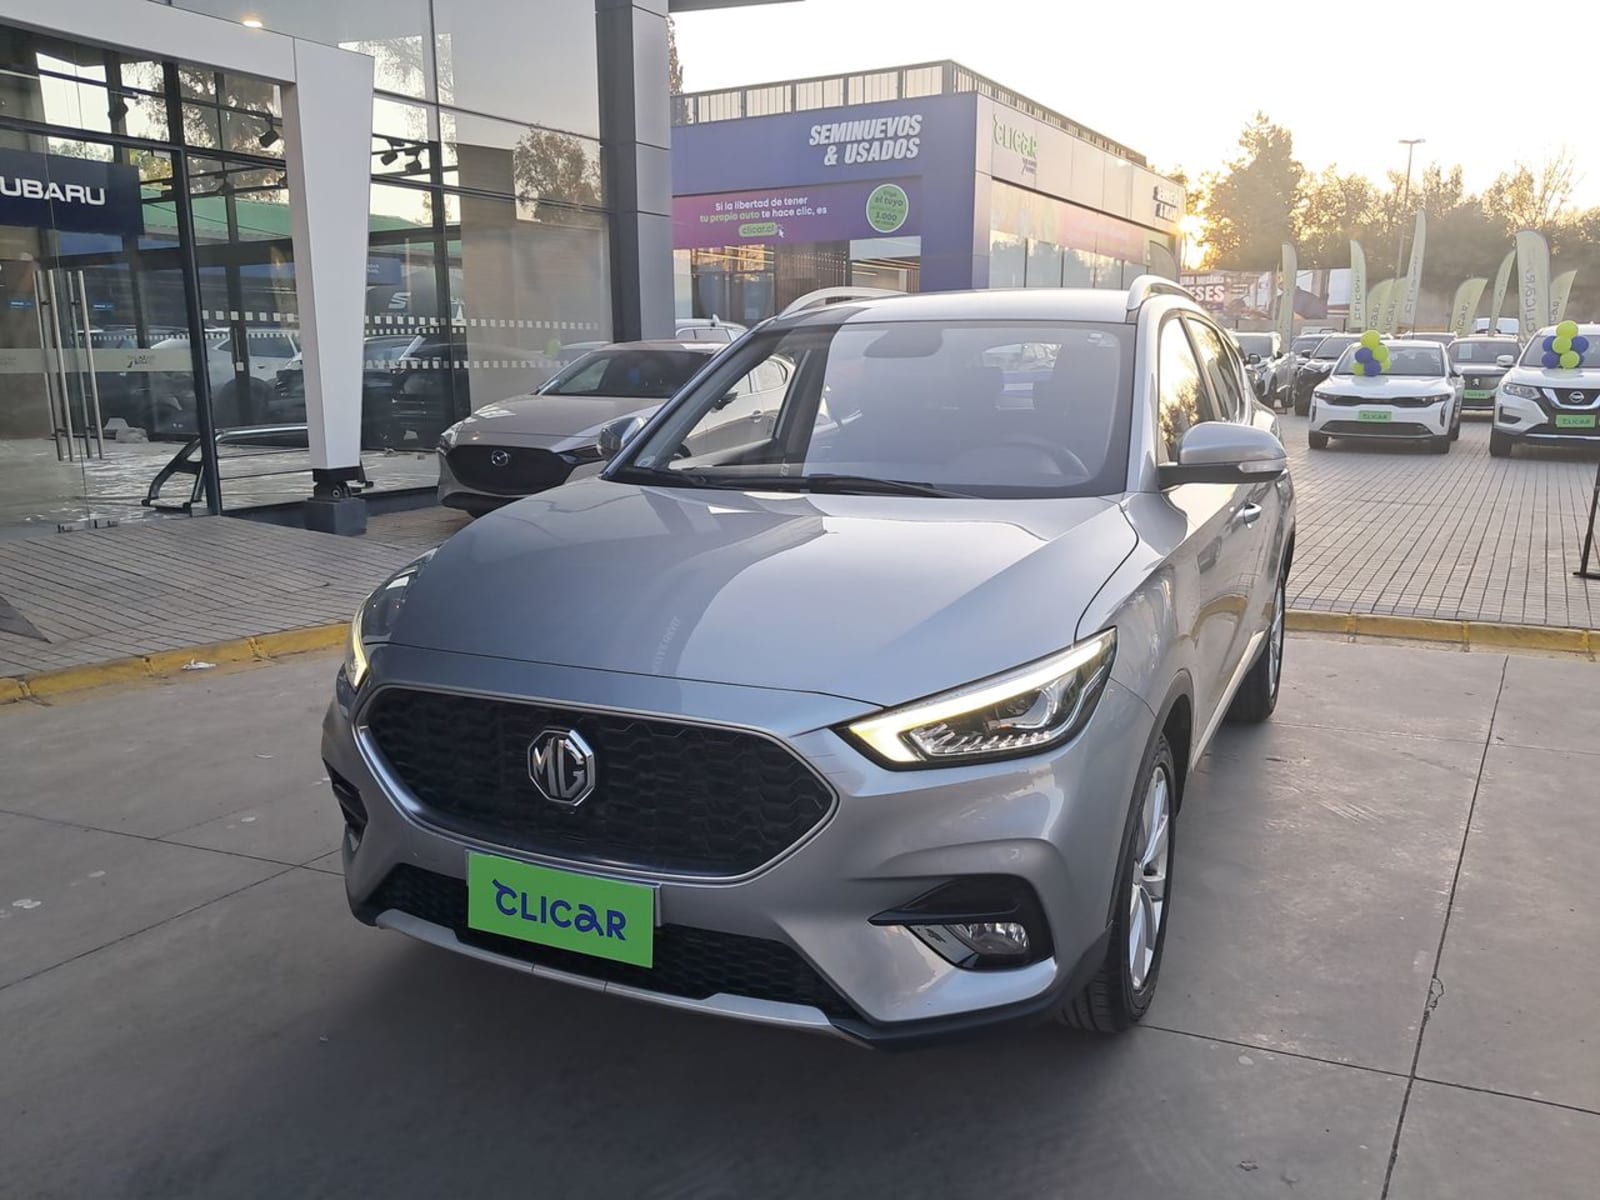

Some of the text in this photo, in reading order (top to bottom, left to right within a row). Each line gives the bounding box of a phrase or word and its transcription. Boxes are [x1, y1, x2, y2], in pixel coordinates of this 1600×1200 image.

[809, 114, 922, 146] SEMINUEVOS
[823, 137, 921, 166] & USADOS
[0, 176, 105, 206] UBARU
[715, 197, 808, 211] Si la libertad de tener
[710, 212, 738, 223] propio
[739, 211, 760, 220] auto
[761, 210, 771, 218] te
[772, 208, 795, 217] hace
[796, 206, 815, 216] clic,
[816, 206, 827, 214] es
[533, 735, 586, 799] MG
